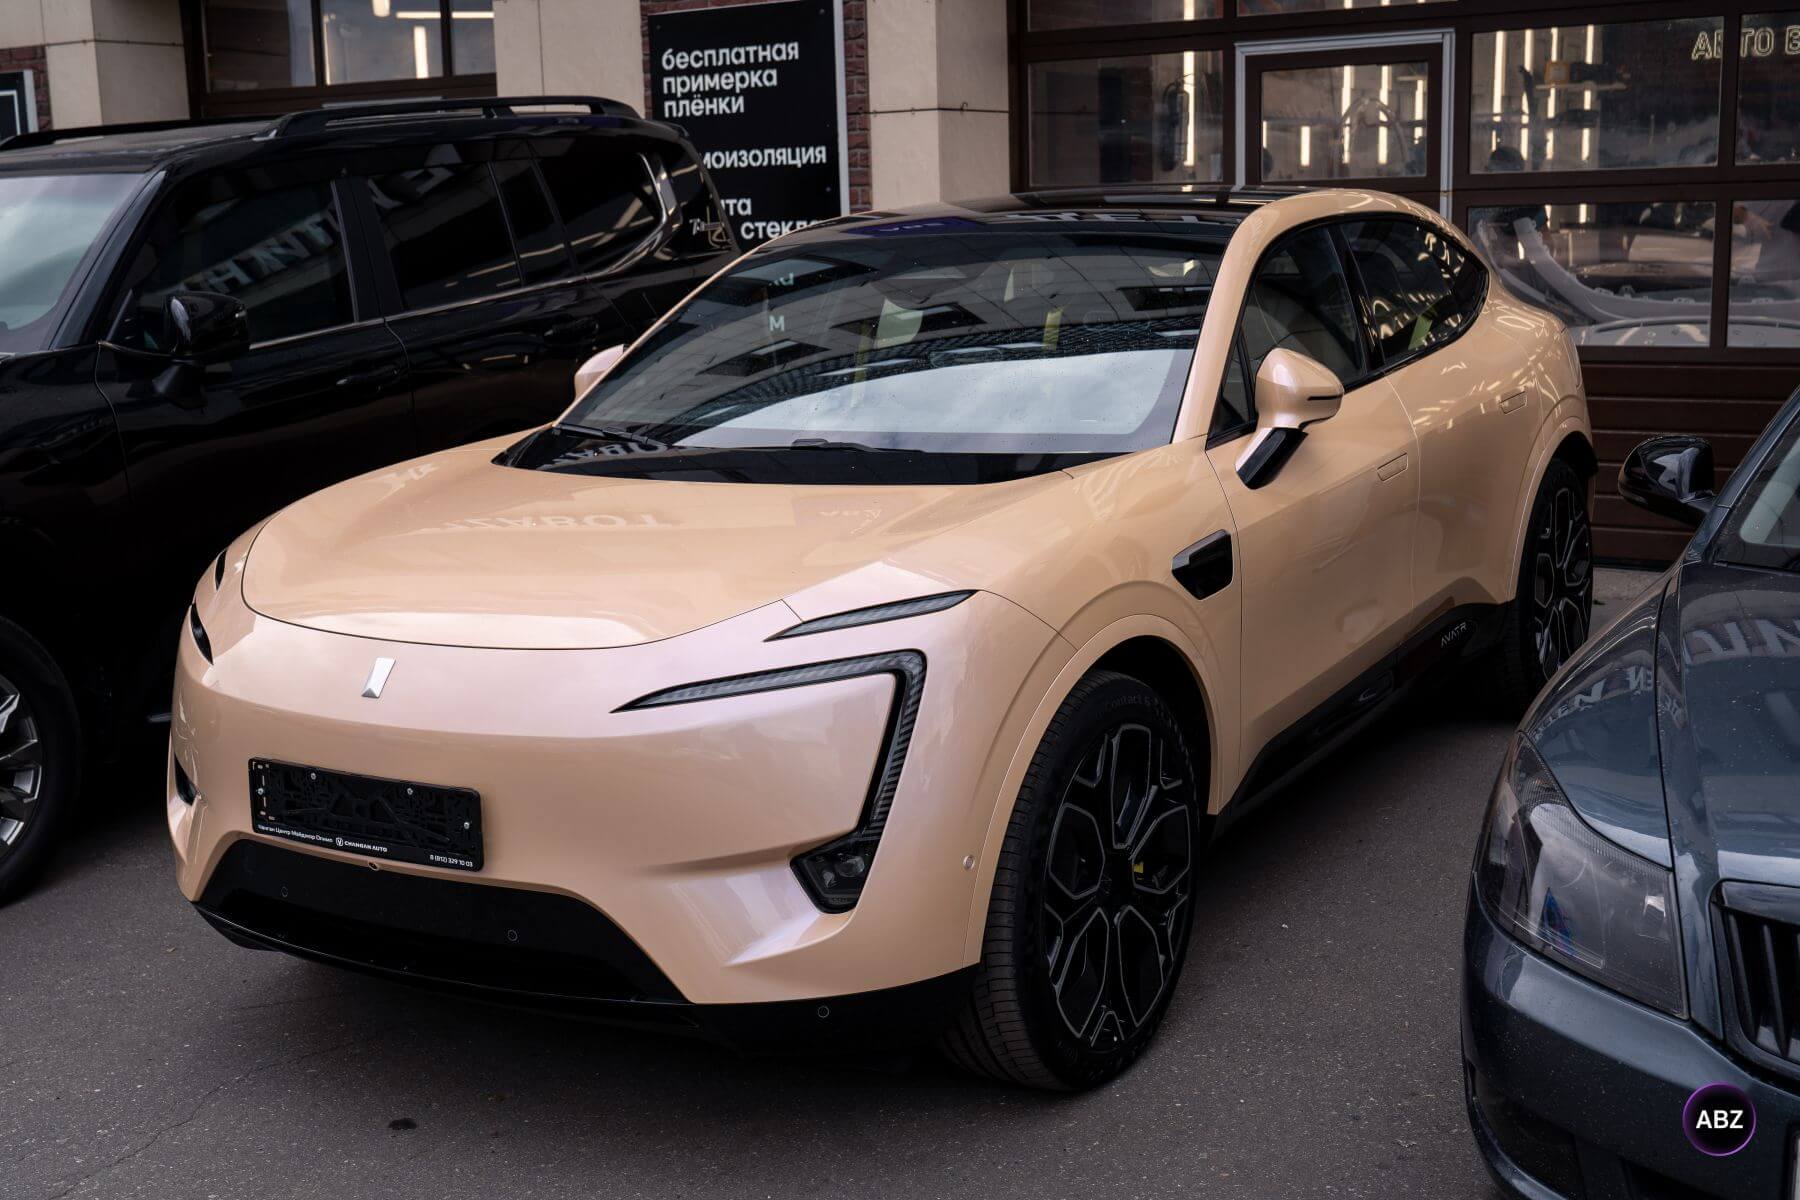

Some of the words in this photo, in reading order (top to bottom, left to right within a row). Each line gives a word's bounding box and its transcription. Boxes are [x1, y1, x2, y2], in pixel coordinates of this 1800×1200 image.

[661, 41, 799, 71] бесплатная
[663, 68, 778, 98] примерка
[664, 94, 745, 118] плёнки
[1440, 621, 1467, 649] AVATR
[344, 840, 372, 850] CHANGAN
[372, 845, 388, 853] AUTO
